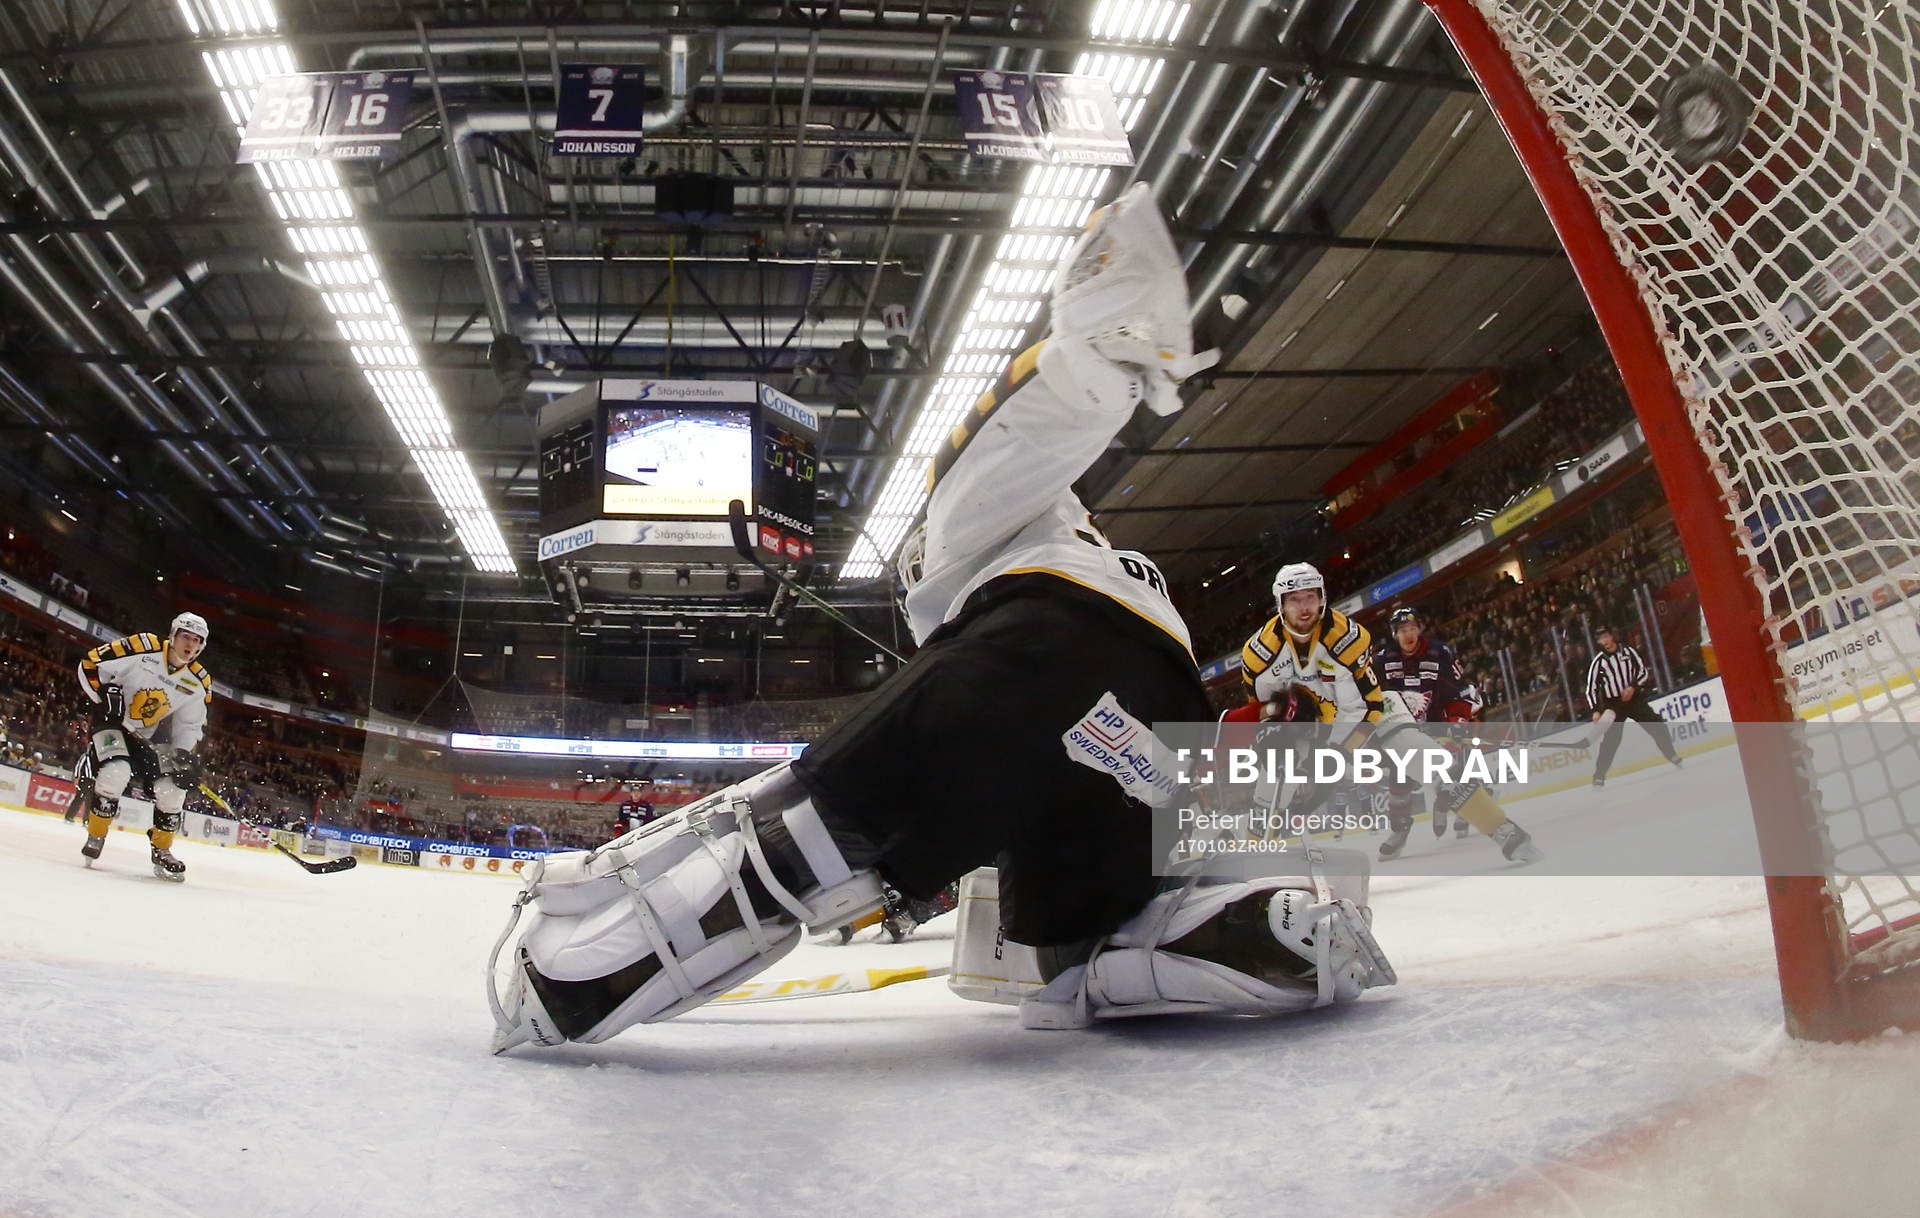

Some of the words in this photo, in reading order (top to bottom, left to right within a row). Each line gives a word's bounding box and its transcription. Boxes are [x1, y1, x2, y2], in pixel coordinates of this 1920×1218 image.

[260, 96, 314, 130] 33
[344, 93, 390, 127] 16
[589, 89, 614, 122] 7
[977, 93, 1021, 128] 15
[1061, 97, 1104, 132] 10
[559, 142, 636, 153] JOHANSSON
[656, 386, 724, 399] Stångåstaden
[763, 386, 817, 427] Corren
[541, 529, 594, 557] Corren
[1094, 706, 1125, 728] HP
[1070, 731, 1123, 770] SWEDEN
[1117, 769, 1136, 785] AB
[1529, 748, 1592, 774] ARENA
[34, 785, 76, 805] CC
[350, 833, 412, 850] COMBITECH
[429, 843, 490, 857] COMBITECH
